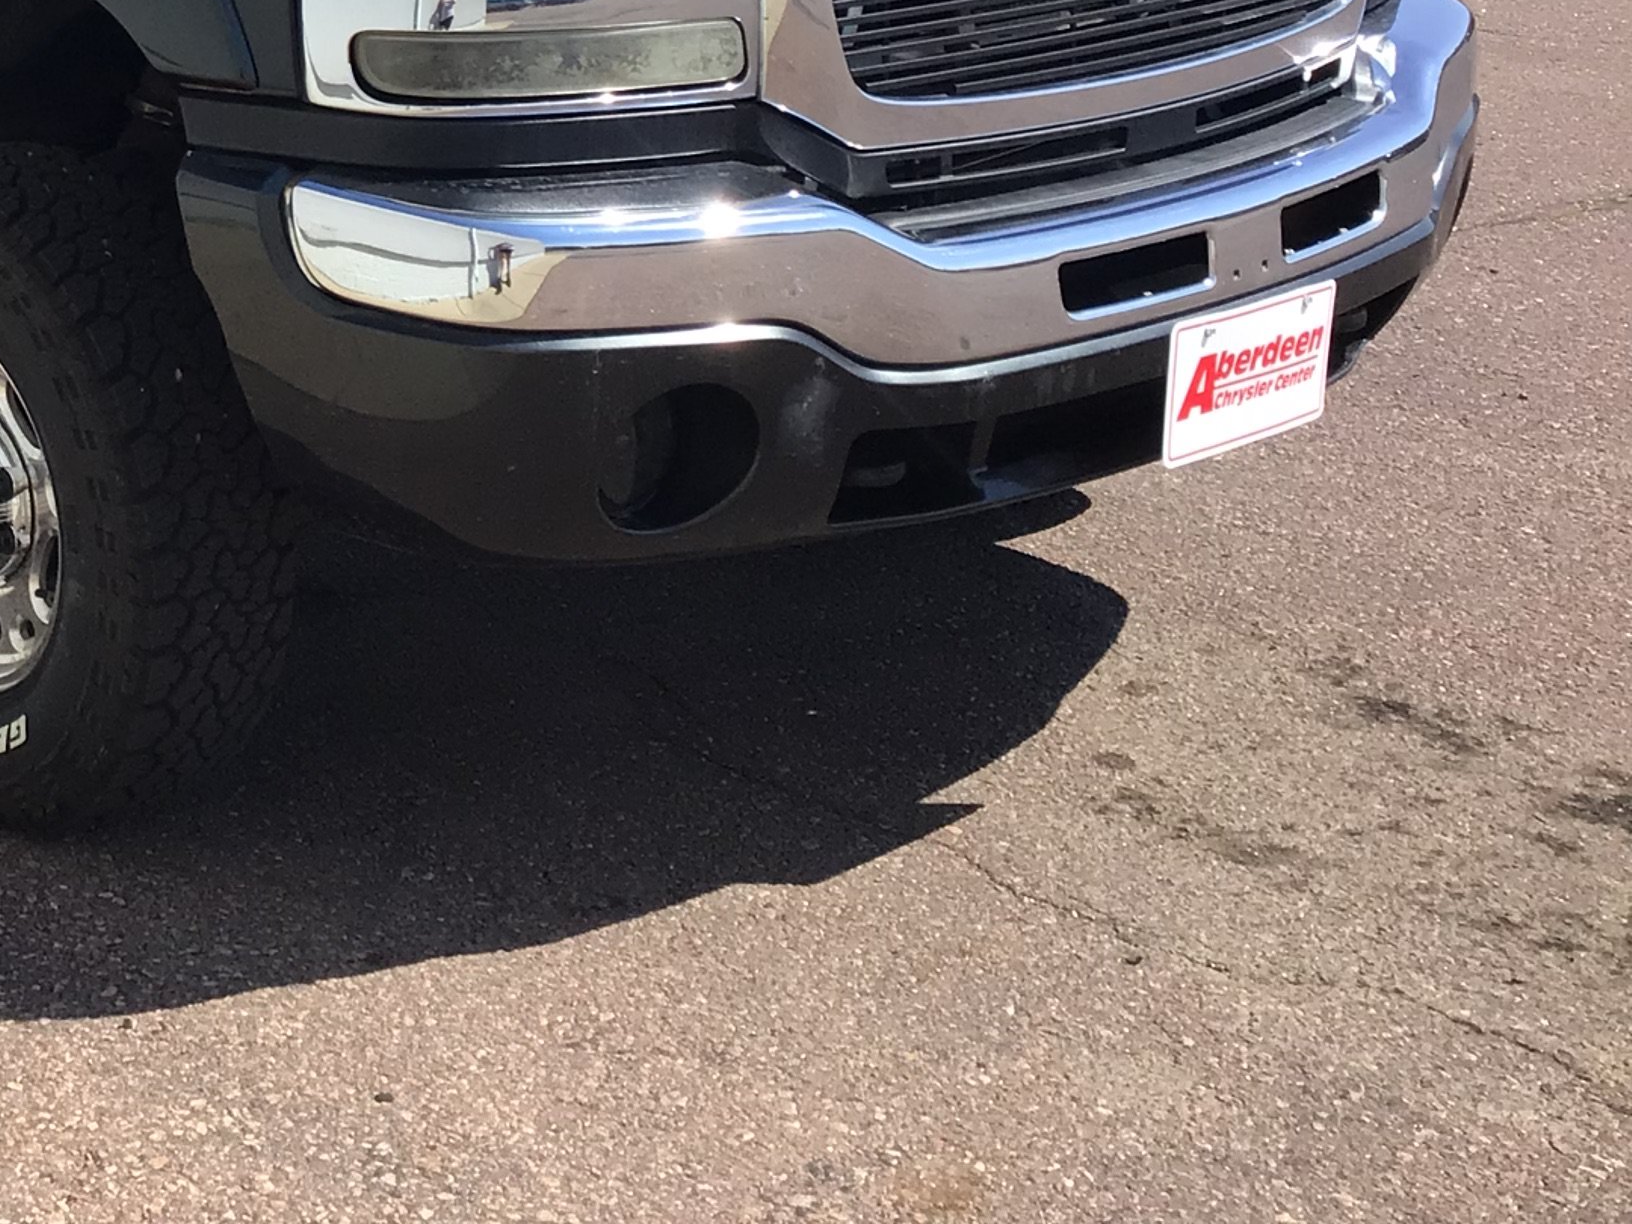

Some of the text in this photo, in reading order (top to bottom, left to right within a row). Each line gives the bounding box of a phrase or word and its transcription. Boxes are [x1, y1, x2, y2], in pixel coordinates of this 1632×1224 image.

[1176, 326, 1324, 422] Aberdeen
[1214, 364, 1316, 410] Chrysler Center
